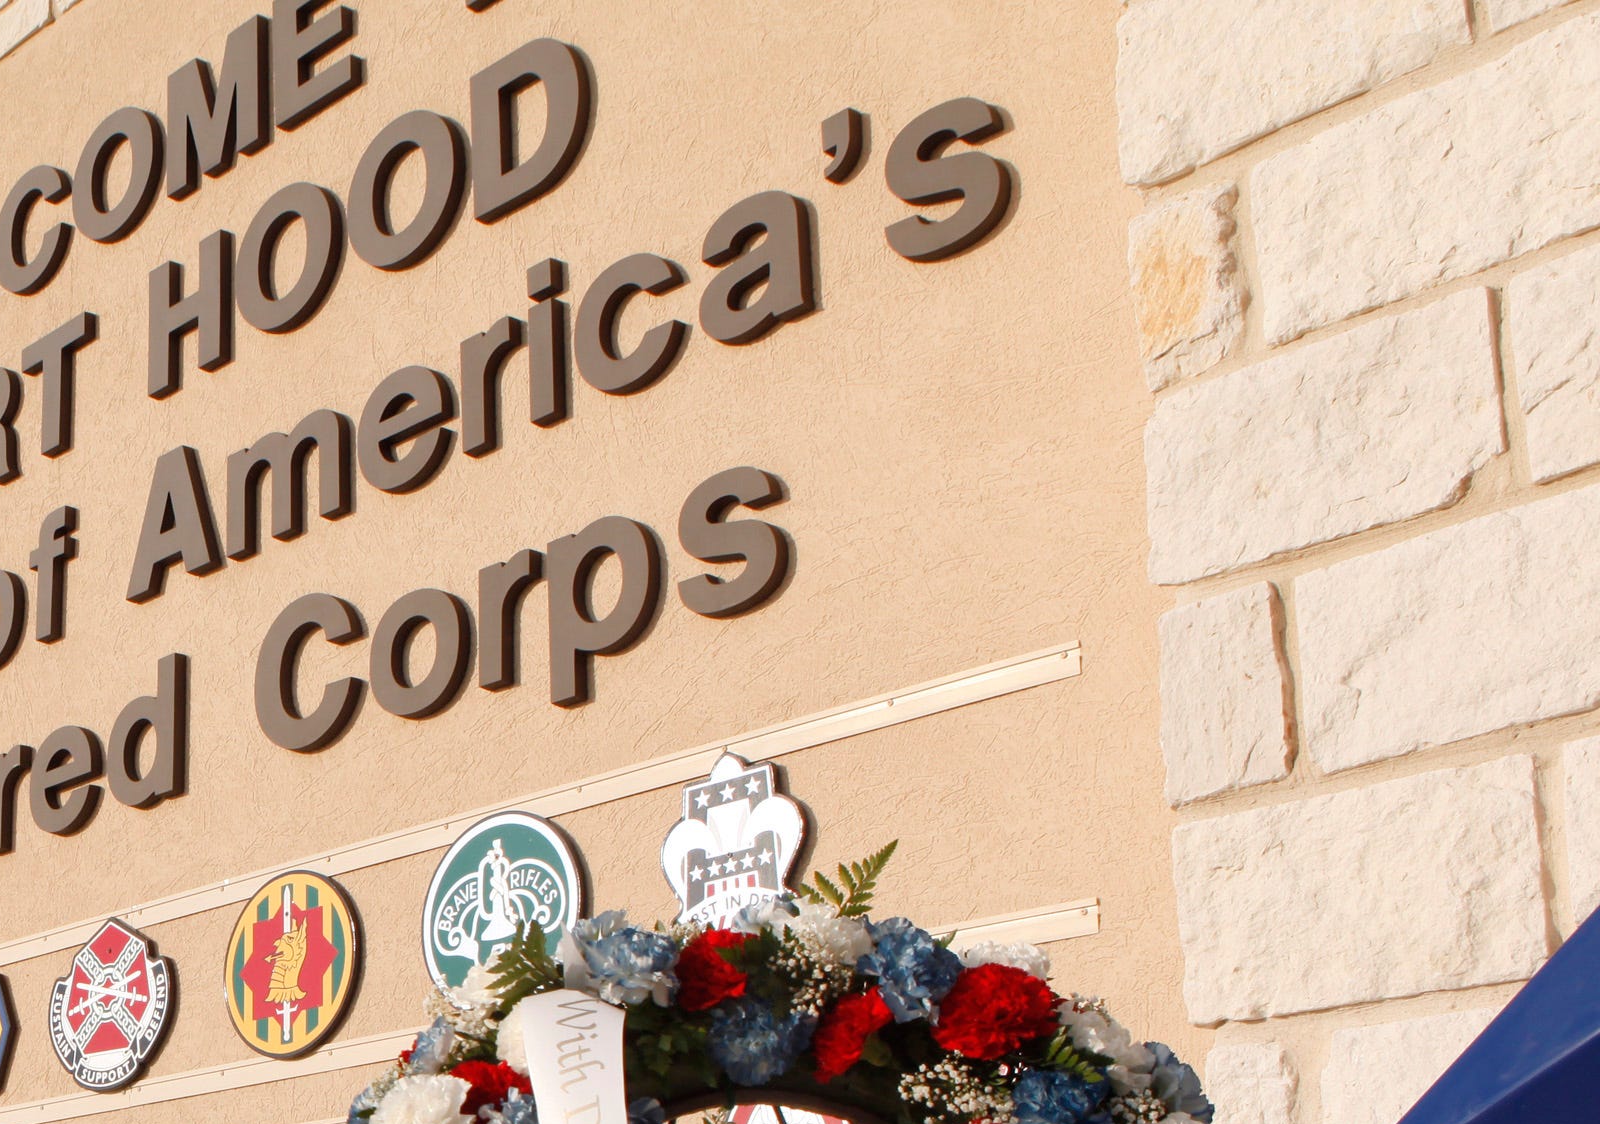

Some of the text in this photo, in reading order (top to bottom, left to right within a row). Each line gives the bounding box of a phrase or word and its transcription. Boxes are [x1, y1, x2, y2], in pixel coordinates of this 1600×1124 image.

[148, 37, 598, 401] HOOD
[126, 97, 1018, 604] America's
[254, 466, 792, 755] Corps
[438, 868, 558, 933] BRAVE RIFLES
[725, 894, 741, 910] IN
[51, 992, 72, 1059] SUSTAIN
[144, 973, 167, 1042] DEFEND
[81, 1060, 132, 1084] SUPPORT
[555, 999, 606, 1094] With
